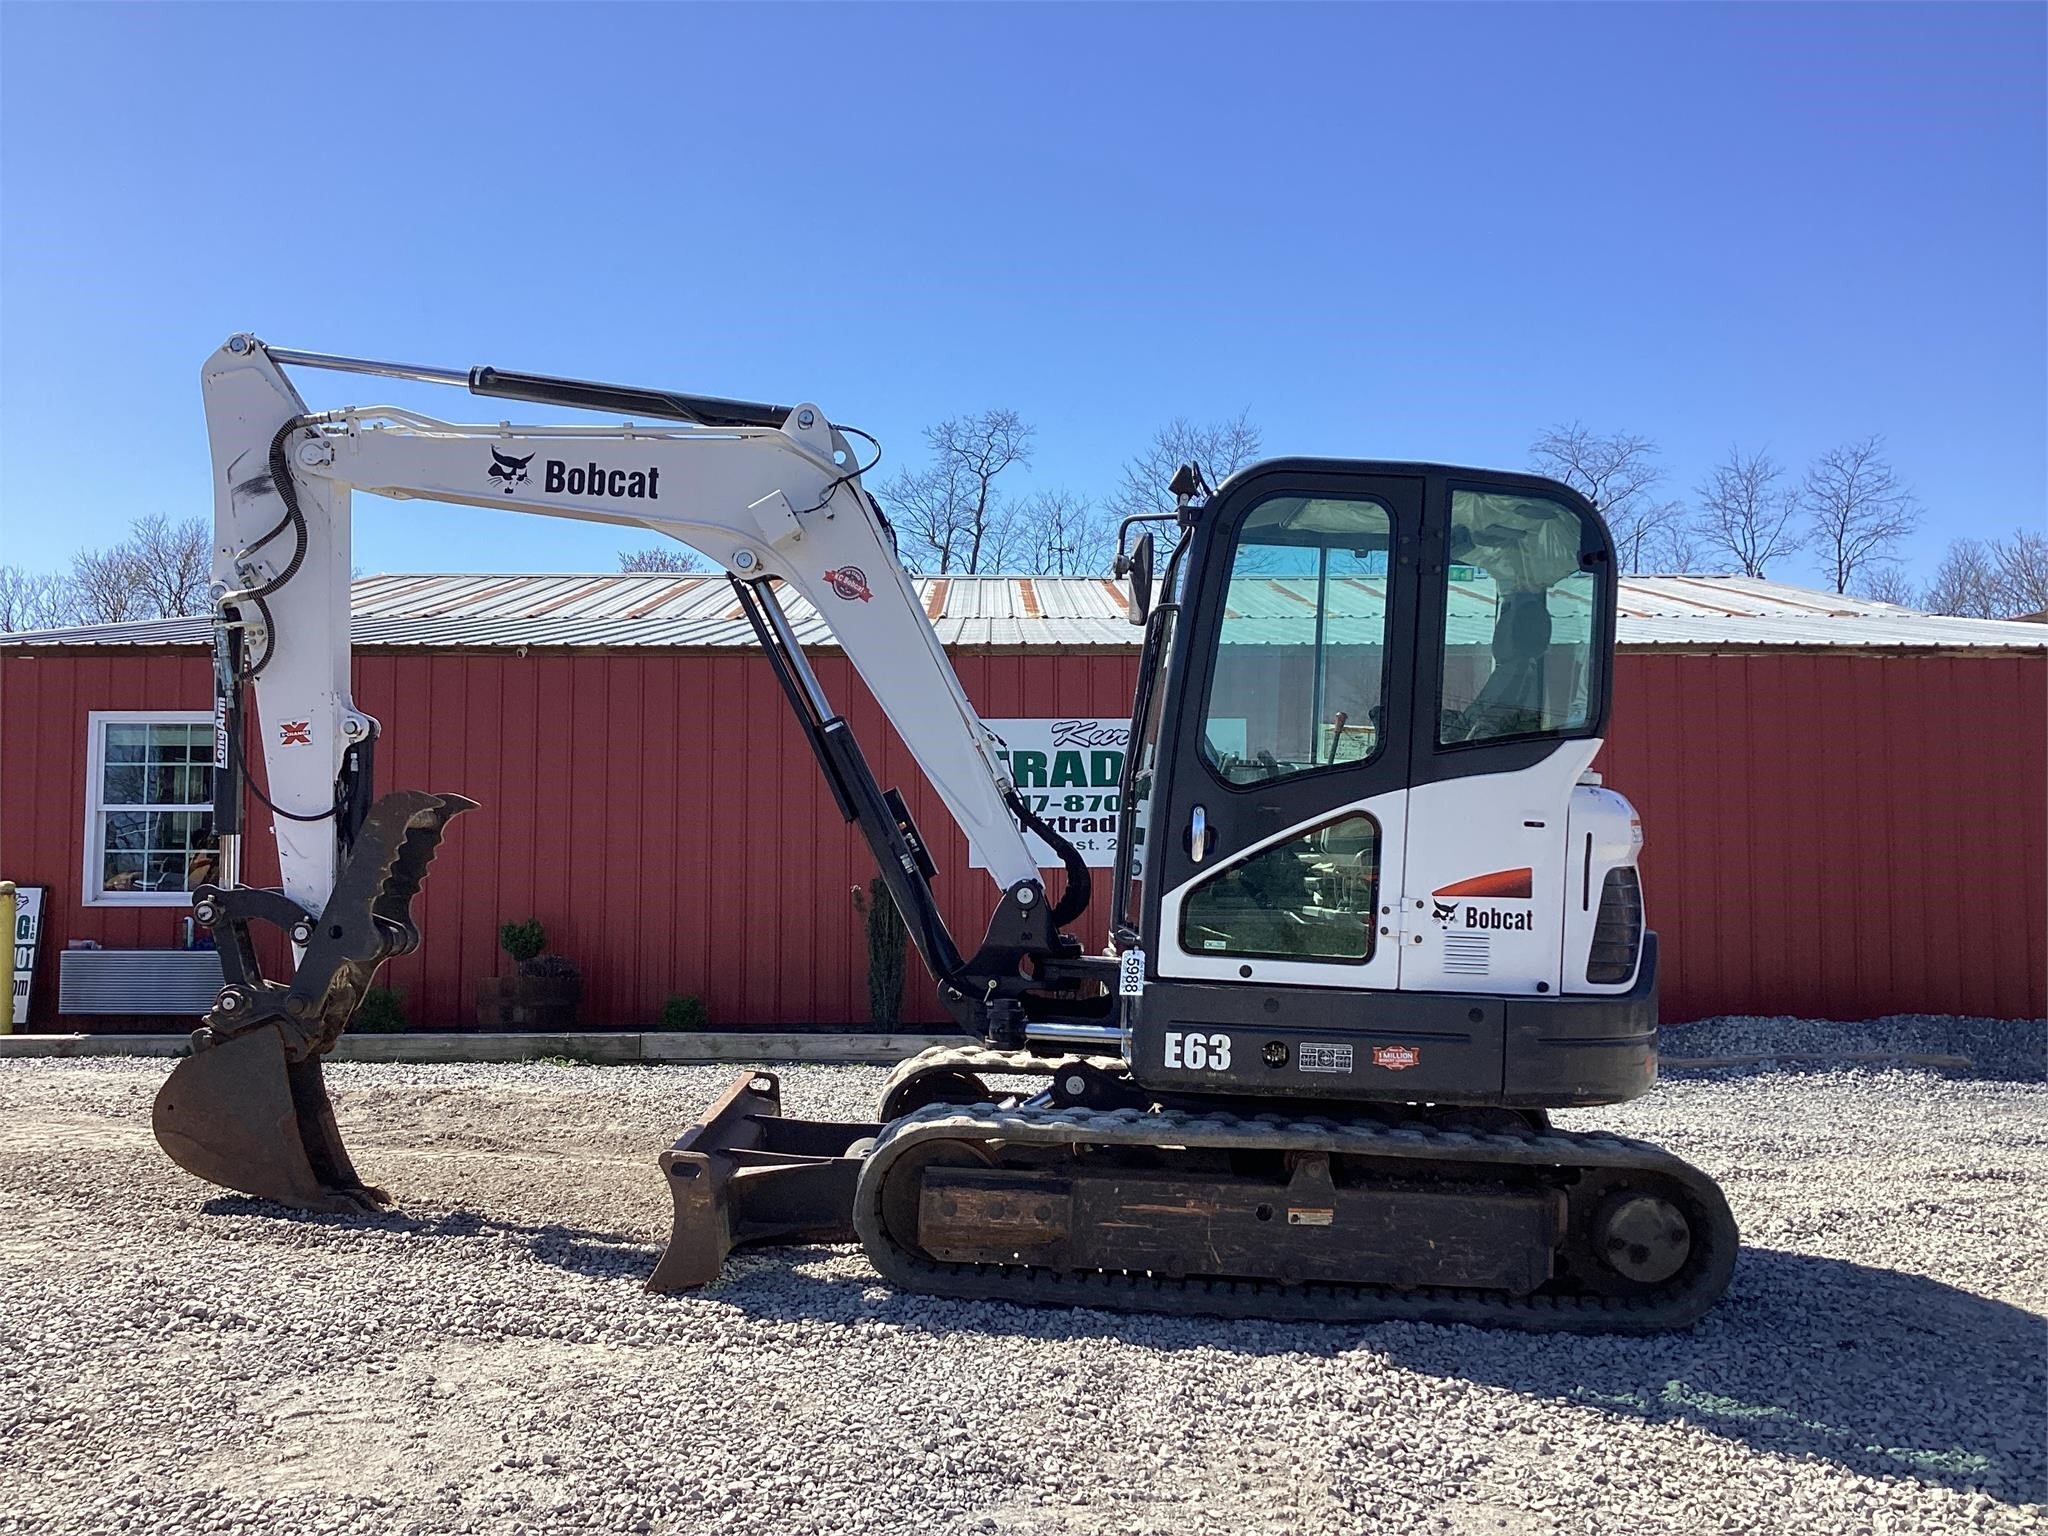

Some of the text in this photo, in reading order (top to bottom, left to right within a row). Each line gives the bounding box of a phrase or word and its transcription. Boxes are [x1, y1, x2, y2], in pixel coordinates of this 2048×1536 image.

[545, 460, 660, 500] Bobcat
[215, 697, 228, 769] LongArm
[1072, 838, 1100, 851] st.
[16, 915, 31, 940] G
[1465, 906, 1534, 931] Bobcat
[14, 946, 35, 969] 01
[1125, 957, 1140, 993] 5988
[1164, 1032, 1232, 1071] E63
